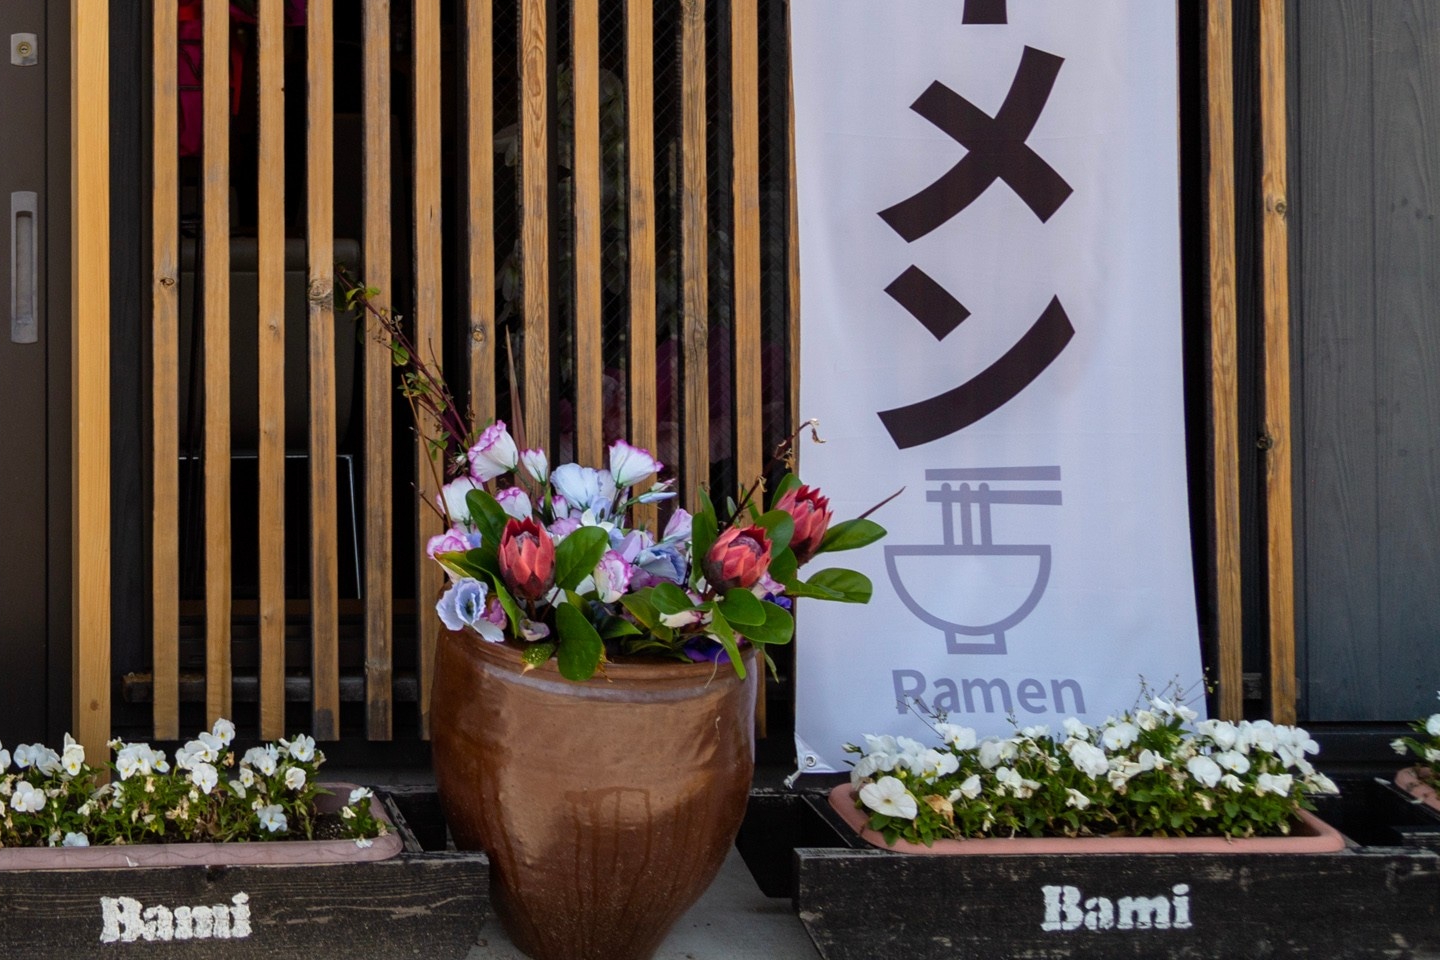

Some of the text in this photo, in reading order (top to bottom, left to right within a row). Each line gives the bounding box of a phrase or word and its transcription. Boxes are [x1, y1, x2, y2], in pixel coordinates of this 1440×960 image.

[891, 669, 1087, 715] Ramen
[100, 891, 253, 943] Bami
[1040, 883, 1193, 932] Bami
